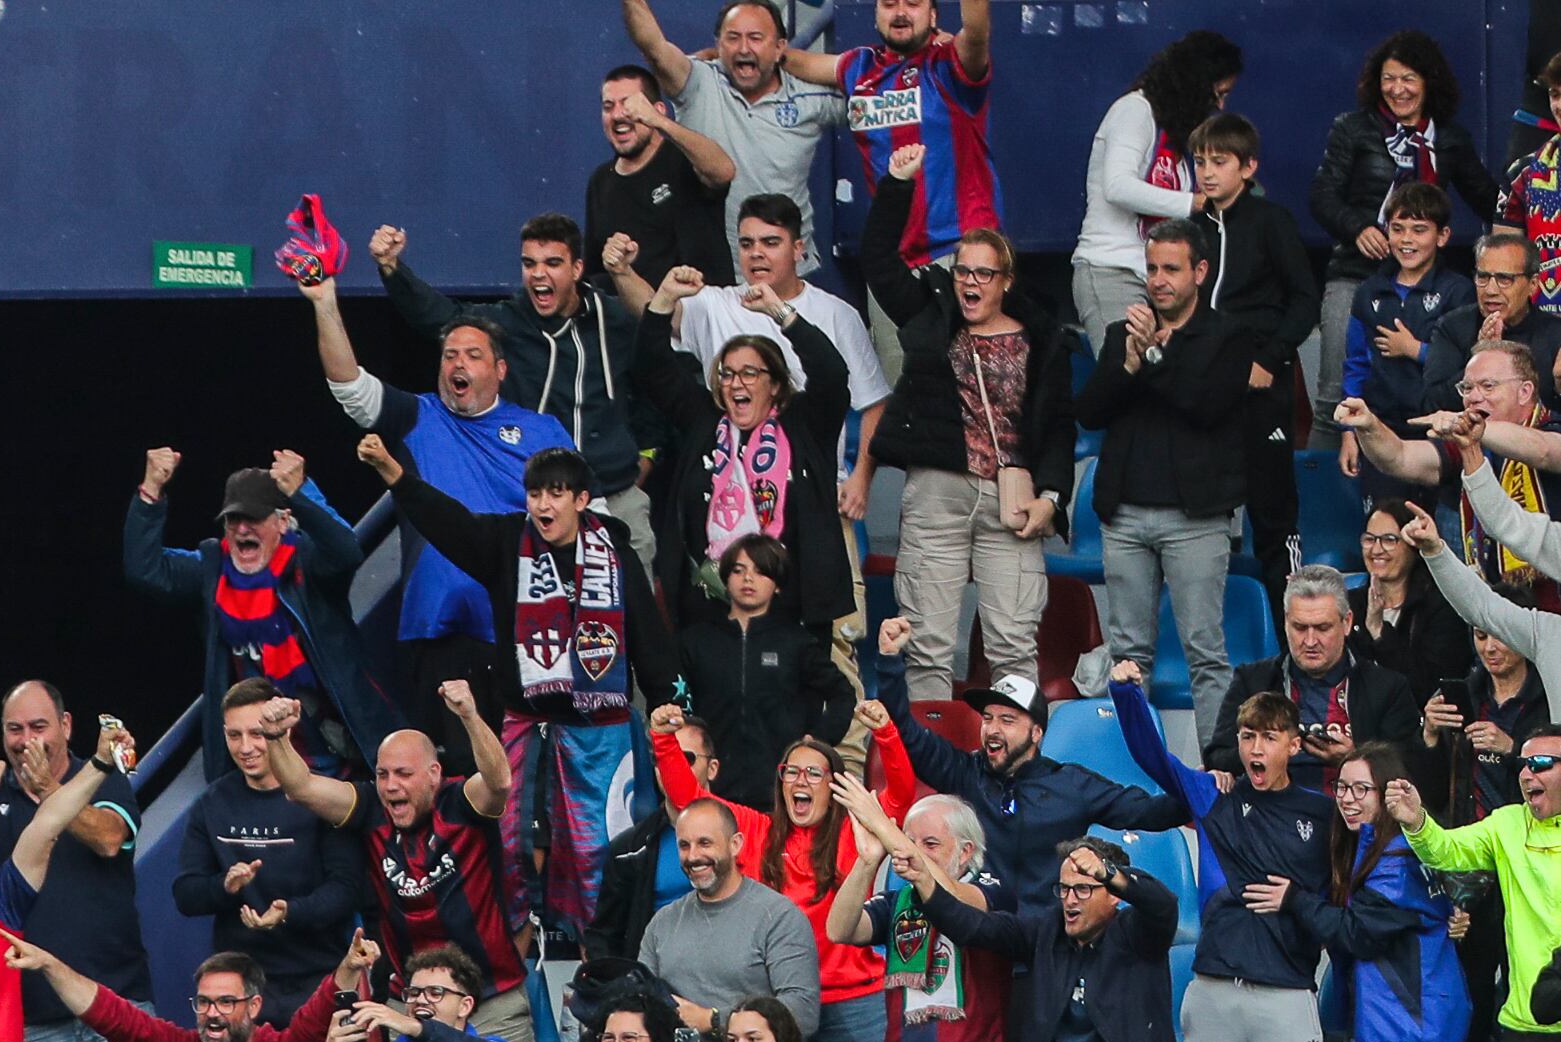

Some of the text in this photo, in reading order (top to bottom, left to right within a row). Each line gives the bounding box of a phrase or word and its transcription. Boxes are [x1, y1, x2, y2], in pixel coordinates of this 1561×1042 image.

[168, 249, 236, 268] SALIDA DE
[158, 267, 244, 287] EMERGENCIA
[230, 826, 280, 836] PARIS
